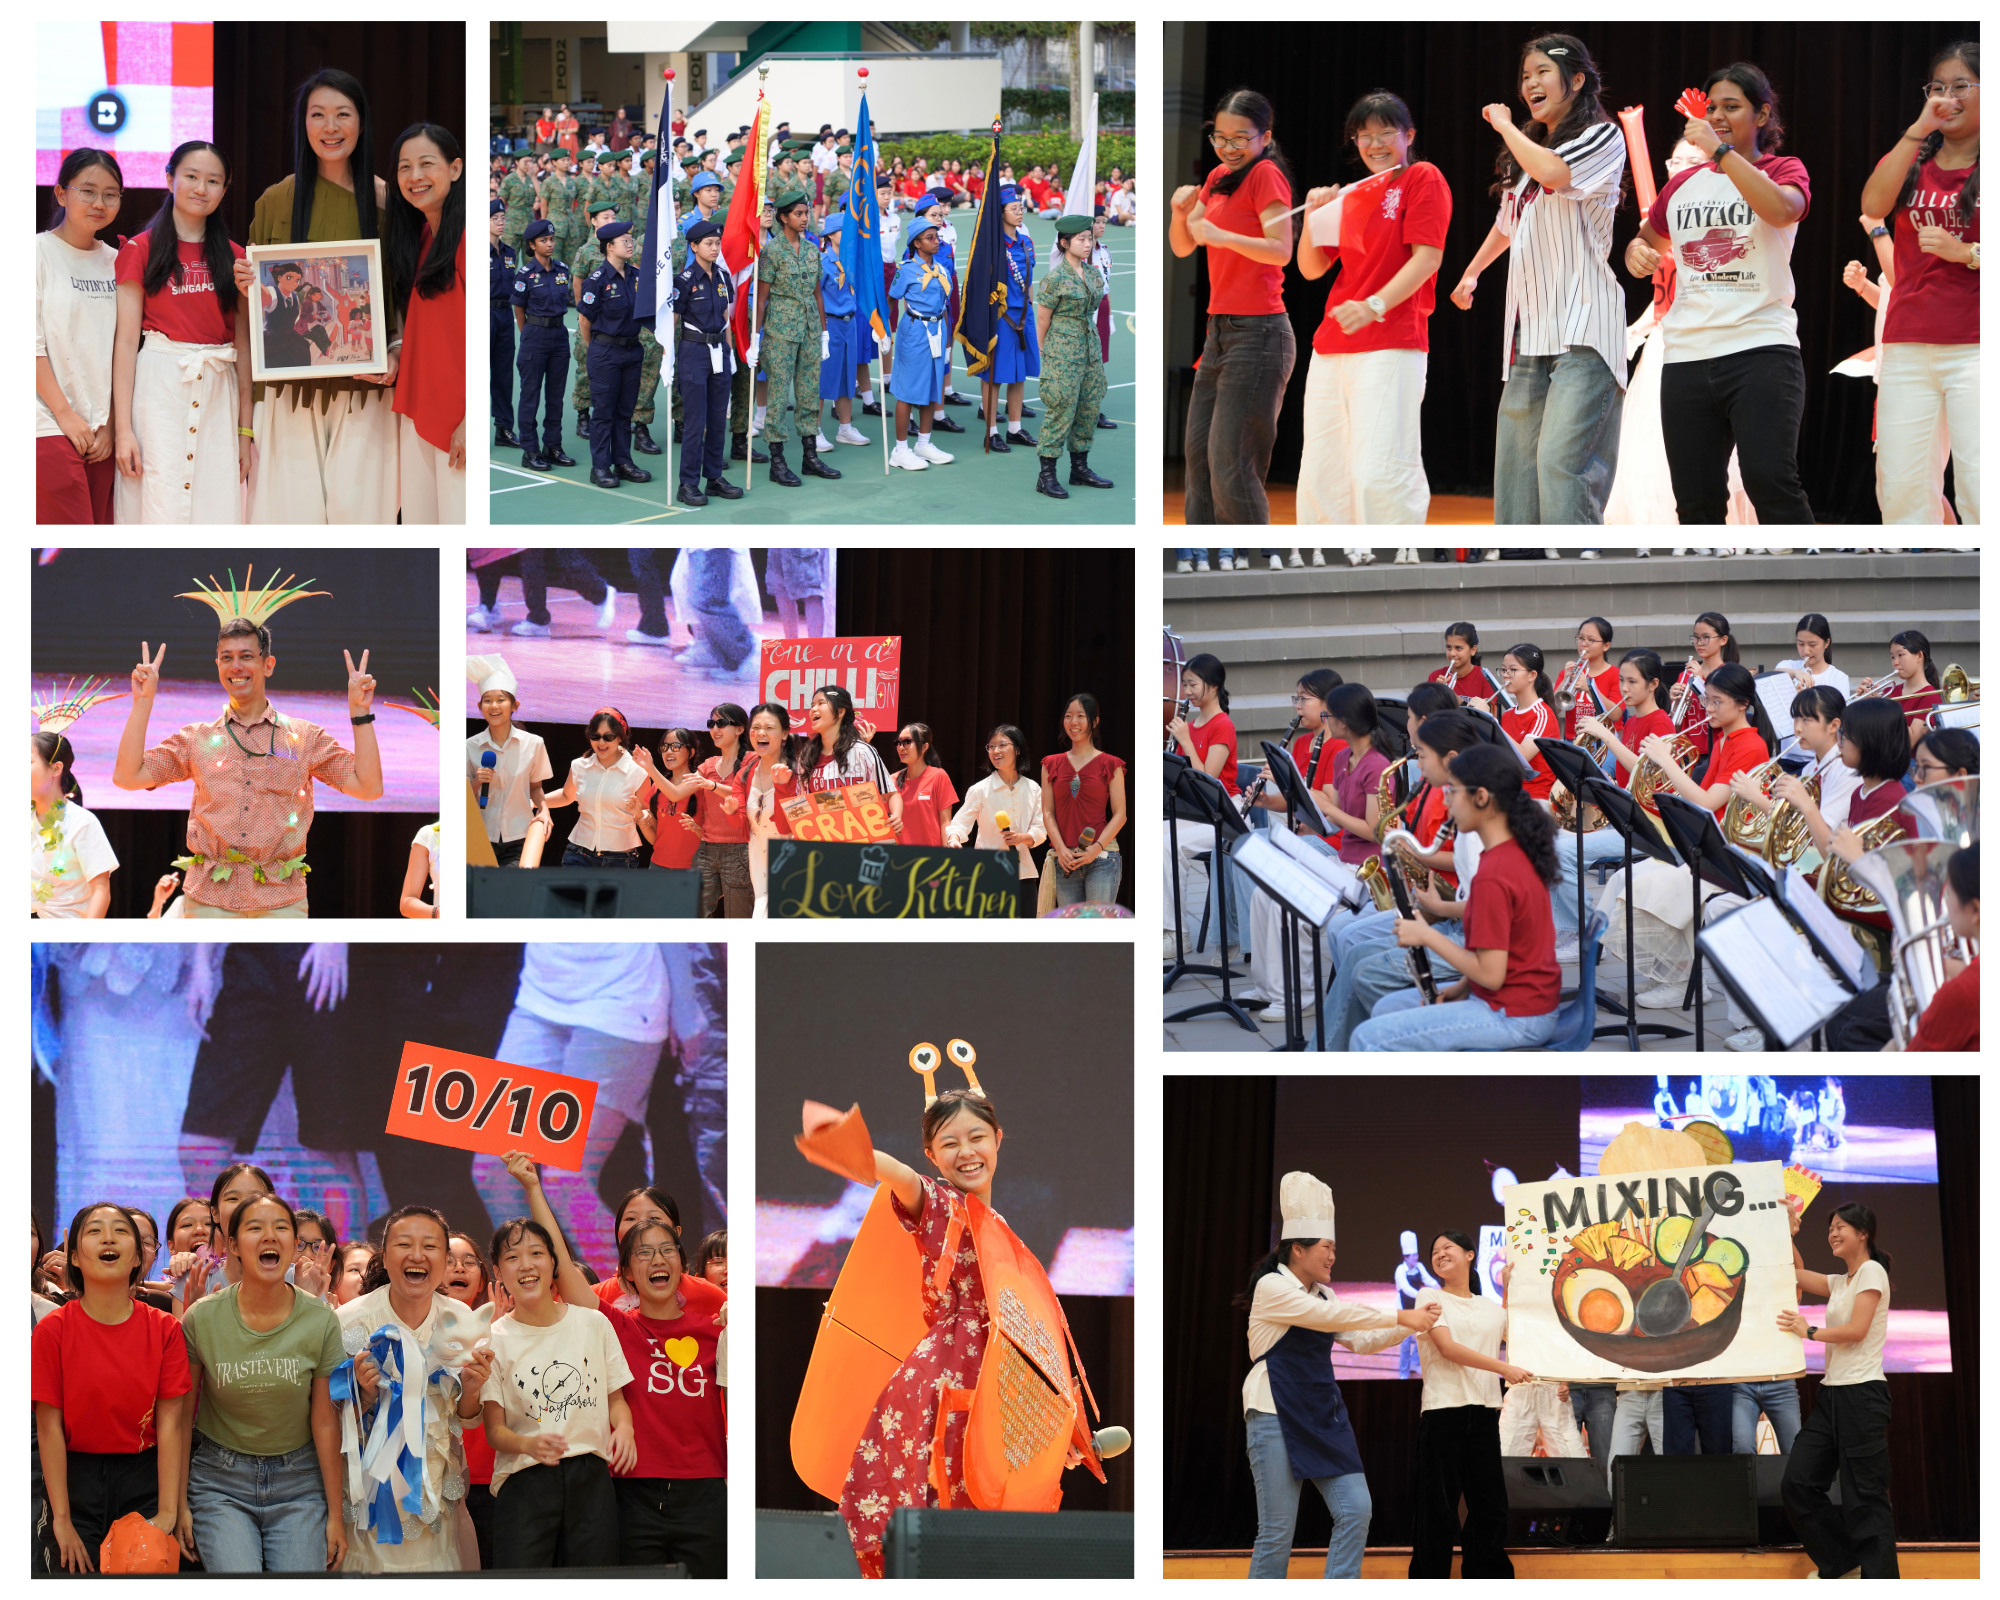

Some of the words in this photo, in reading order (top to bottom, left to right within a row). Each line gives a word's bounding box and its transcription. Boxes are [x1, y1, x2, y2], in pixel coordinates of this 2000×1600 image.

[556, 38, 567, 90] POD2
[1677, 201, 1756, 231] VINTAGE
[171, 282, 215, 295] SINGAPO
[1710, 273, 1738, 281] Modern
[1741, 271, 1756, 280] Life
[769, 644, 823, 665] one
[831, 640, 858, 663] in
[864, 643, 895, 663] a
[795, 803, 891, 843] CRAB
[779, 849, 893, 919] Love
[891, 856, 1018, 919] Kitchen
[405, 1063, 583, 1144] 10/10
[215, 1356, 301, 1388] TRASTÉVERE
[647, 1360, 708, 1398] SG
